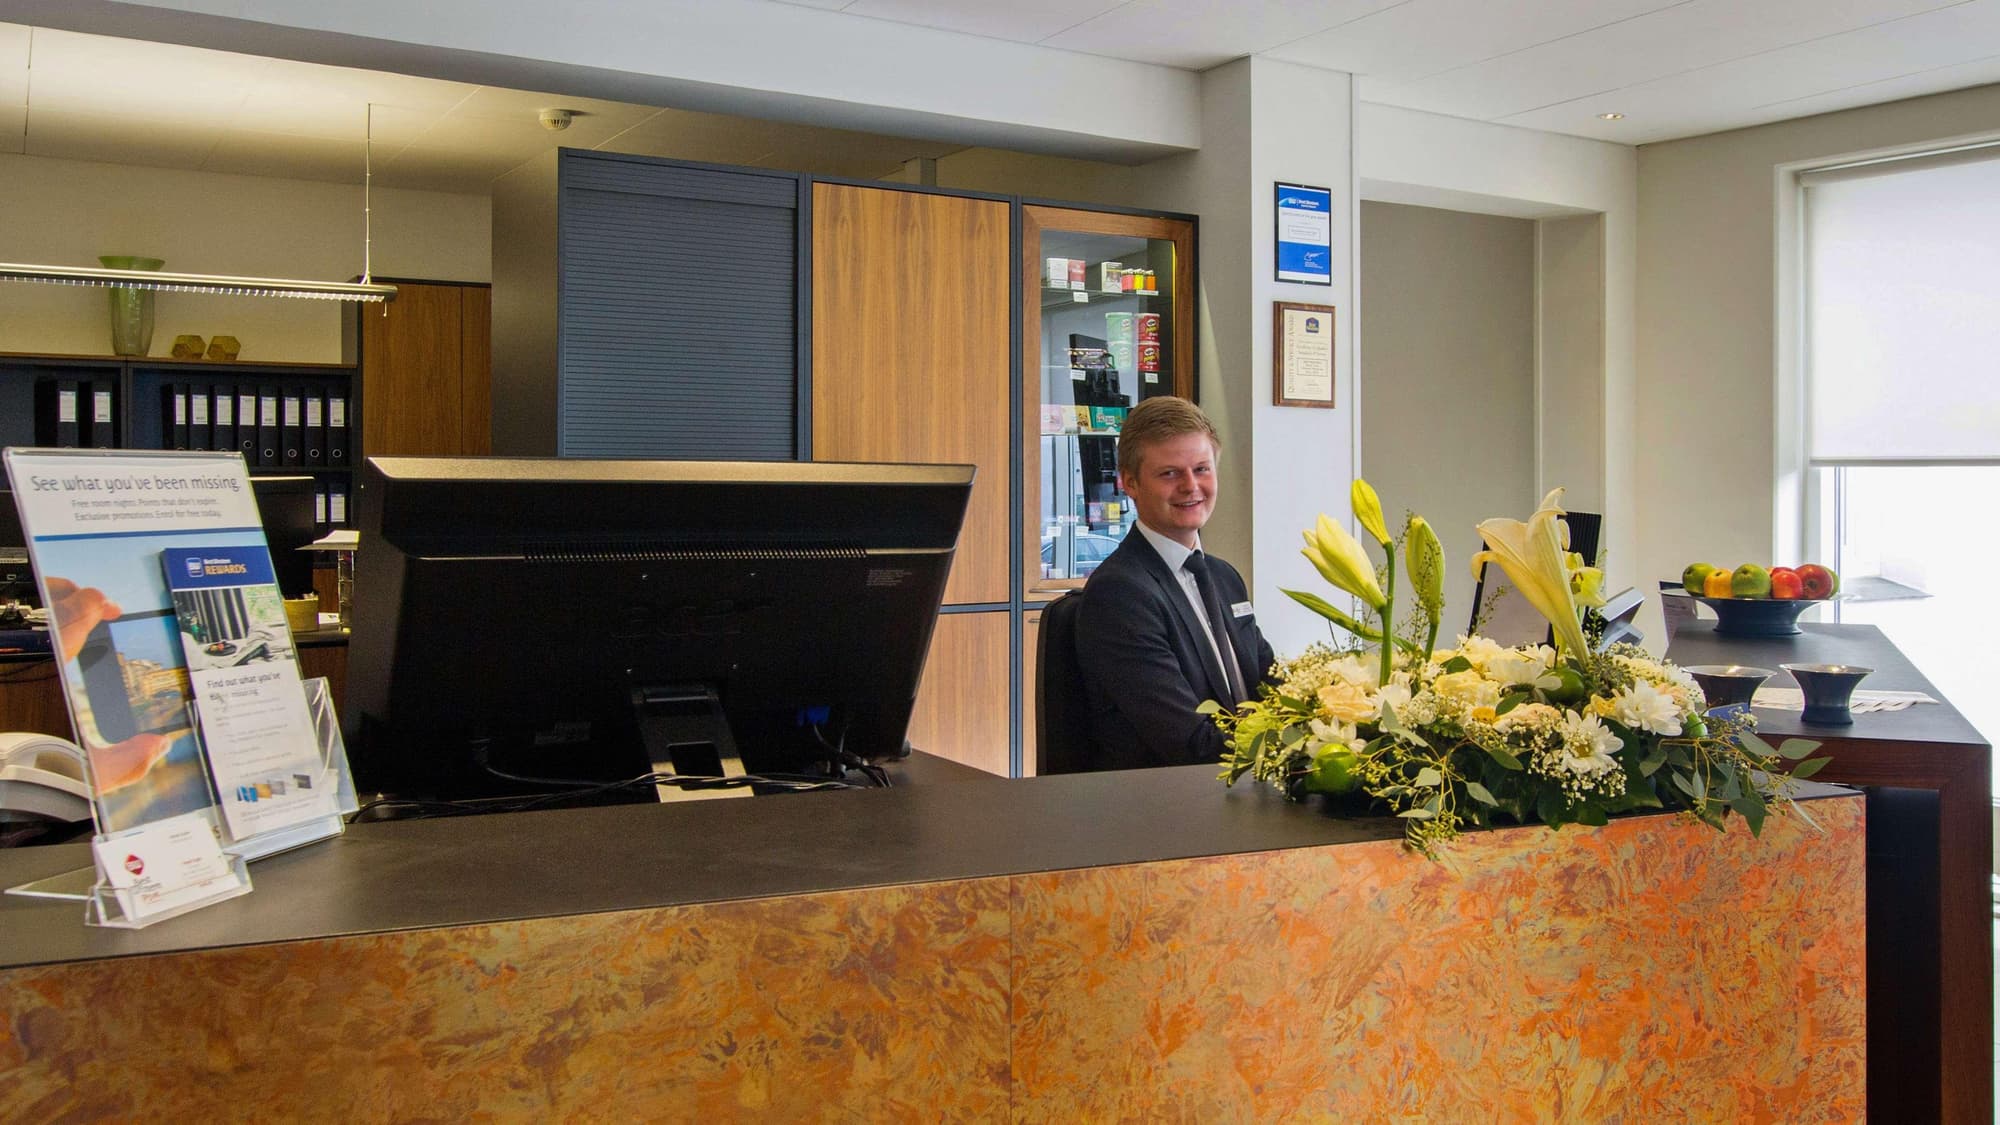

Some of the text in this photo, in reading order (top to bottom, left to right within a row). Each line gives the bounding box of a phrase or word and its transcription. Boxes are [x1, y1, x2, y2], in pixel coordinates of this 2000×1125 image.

[31, 475, 59, 491] See
[62, 475, 103, 491] what
[105, 475, 152, 494] you've
[153, 474, 188, 490] been
[205, 563, 248, 576] REWARDS
[207, 679, 224, 689] Find
[225, 678, 238, 687] out
[239, 676, 257, 685] what
